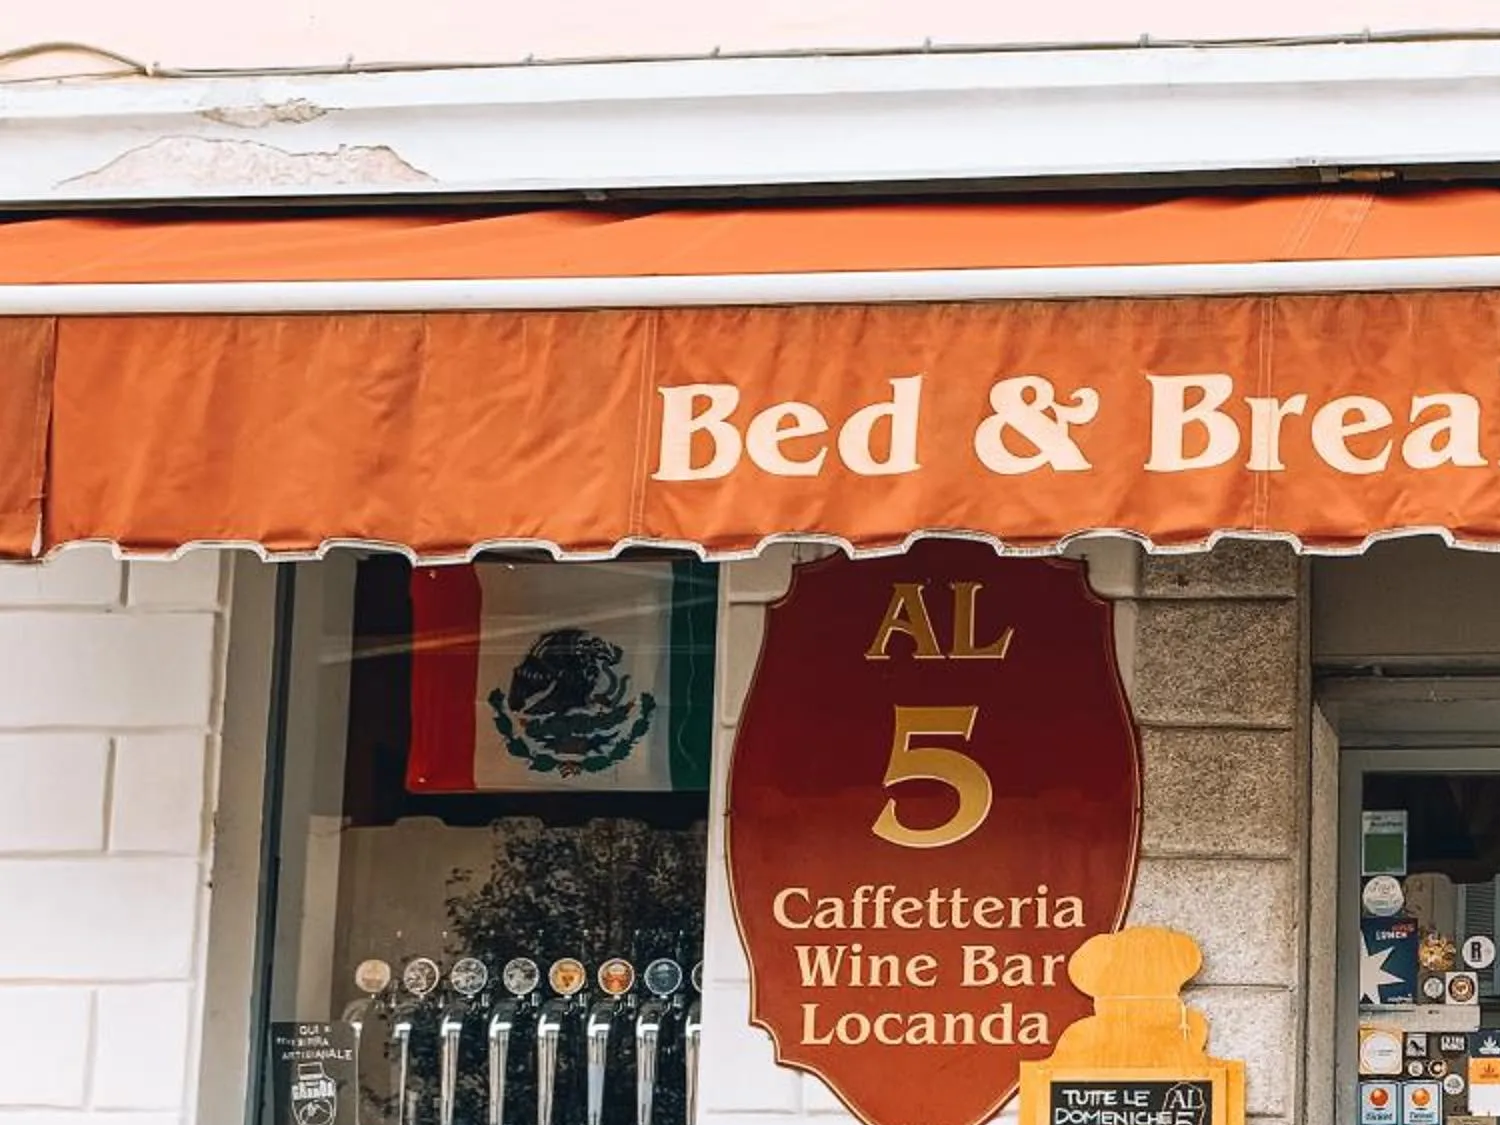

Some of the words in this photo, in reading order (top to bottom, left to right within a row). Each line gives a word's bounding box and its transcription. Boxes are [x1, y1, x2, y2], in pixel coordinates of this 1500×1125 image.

[652, 375, 922, 481] Bed
[974, 374, 1100, 475] &
[864, 582, 1014, 660] AL
[872, 705, 993, 848] 5
[773, 885, 1086, 929] Caffetteria
[795, 943, 938, 988] Wine
[961, 944, 1065, 988] Bar
[800, 1003, 1051, 1046] Locanda
[1061, 1089, 1117, 1107] TUTTE
[1123, 1089, 1150, 1107] LE
[1170, 1089, 1202, 1109] AL
